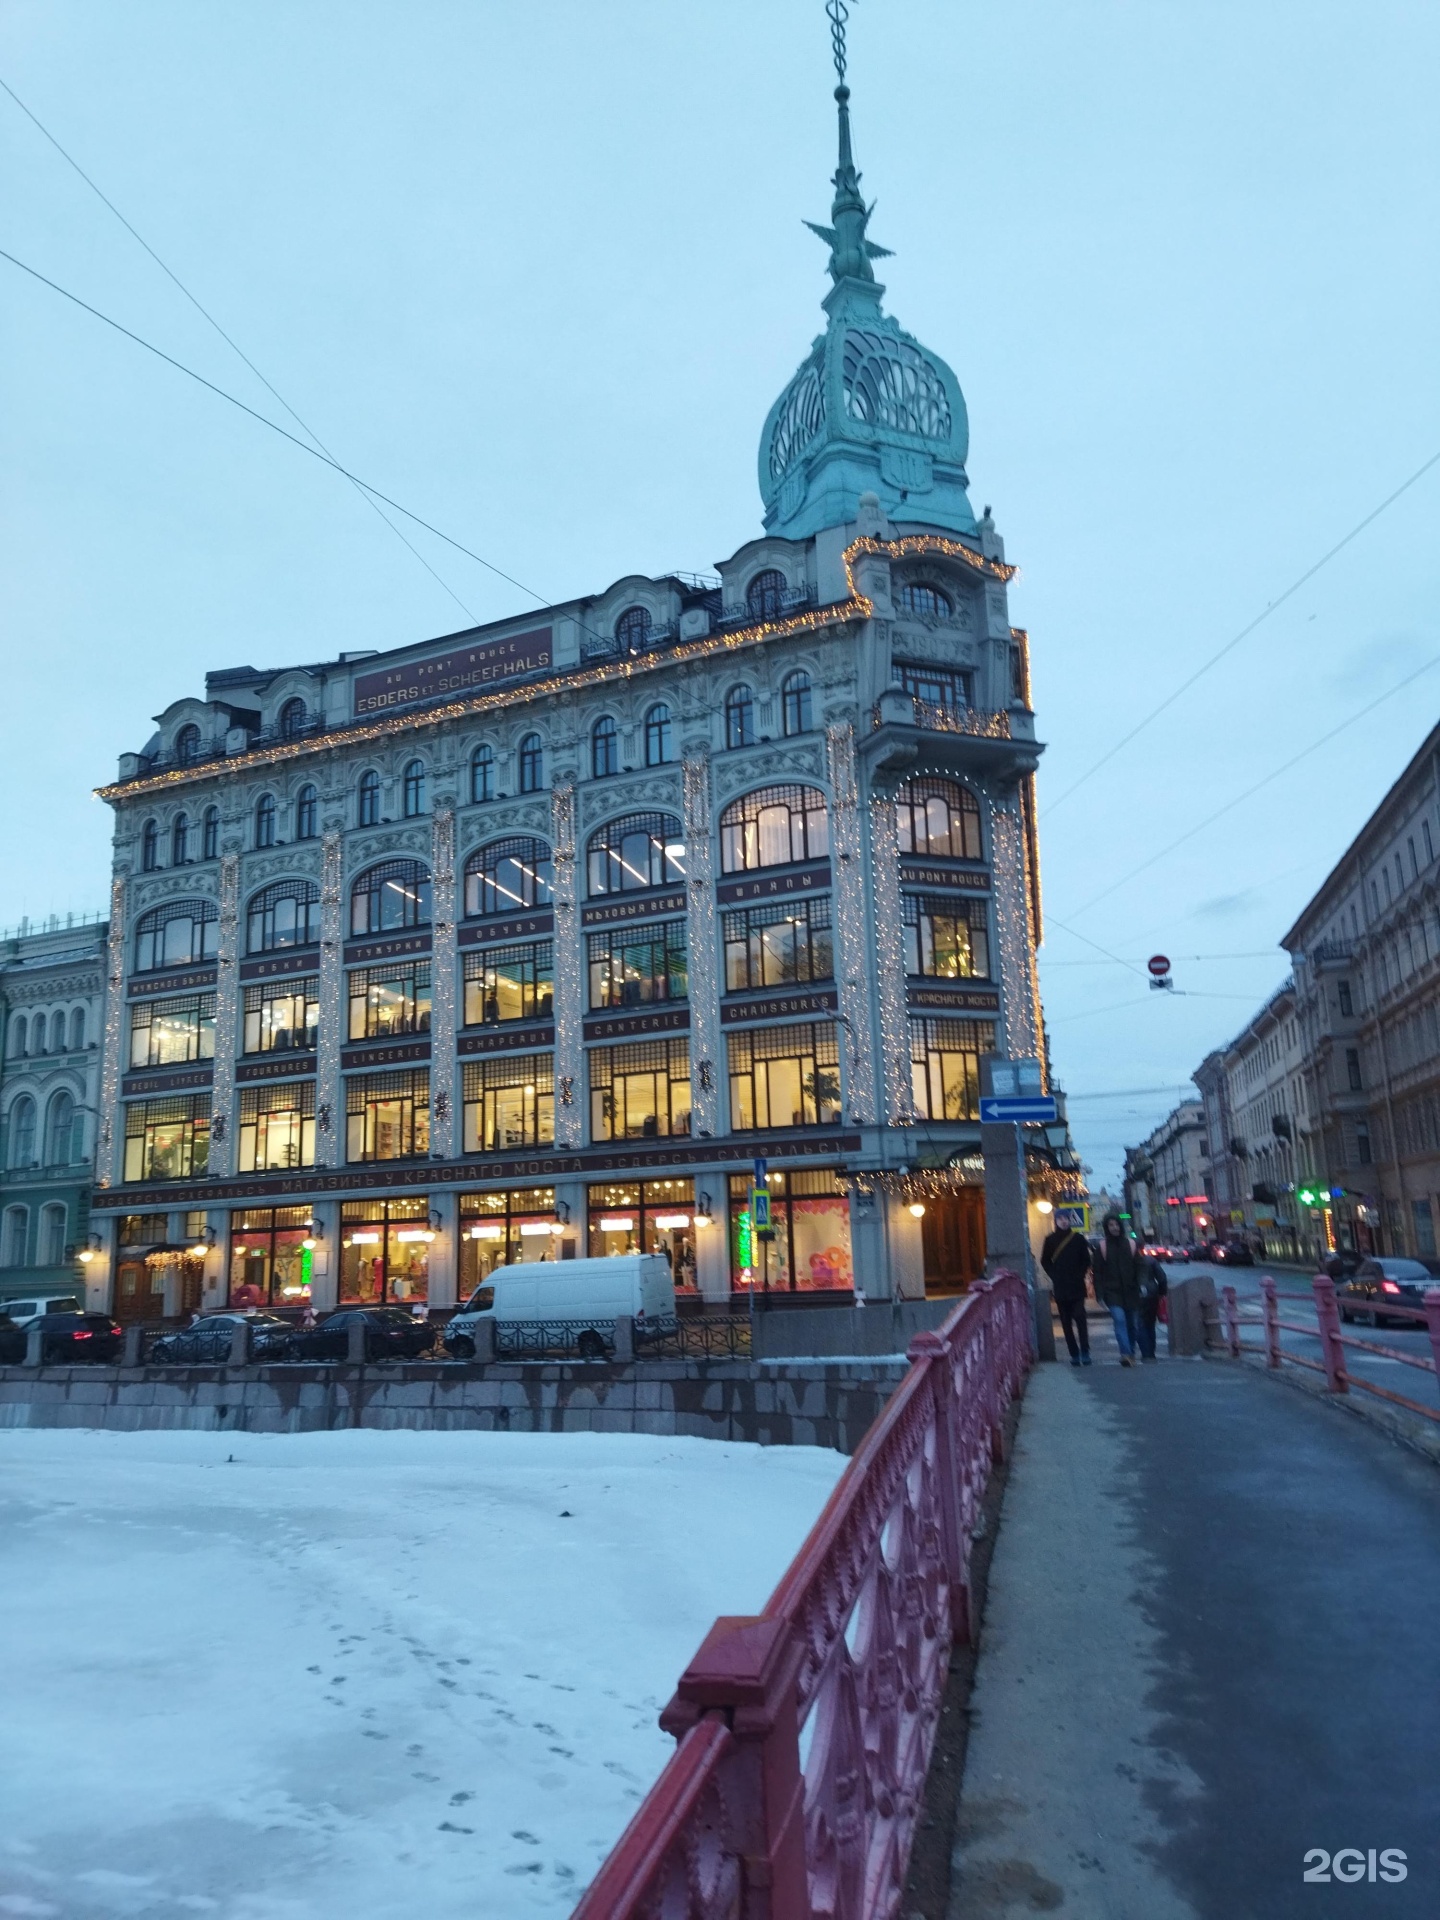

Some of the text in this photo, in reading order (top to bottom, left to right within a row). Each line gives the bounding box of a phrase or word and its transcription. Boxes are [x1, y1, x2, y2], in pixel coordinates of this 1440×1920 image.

[387, 644, 516, 684] AU PONT ROUGE
[358, 686, 418, 712] ESDERS
[438, 652, 549, 691] SCHEEFHALS
[736, 875, 812, 896] ШЛЯПЫ
[919, 870, 947, 883] PONT
[651, 897, 684, 911] ВЕЩИ
[476, 922, 536, 938] ОБУВЬ
[356, 940, 422, 957] ТУЖУРКИ
[729, 996, 829, 1018] CHAUSSURES
[466, 1032, 546, 1050] CHAPEAUX
[246, 1061, 309, 1077] FOURRURES
[404, 1164, 503, 1184] КРАСНАГО
[514, 1158, 583, 1175] МОСТА
